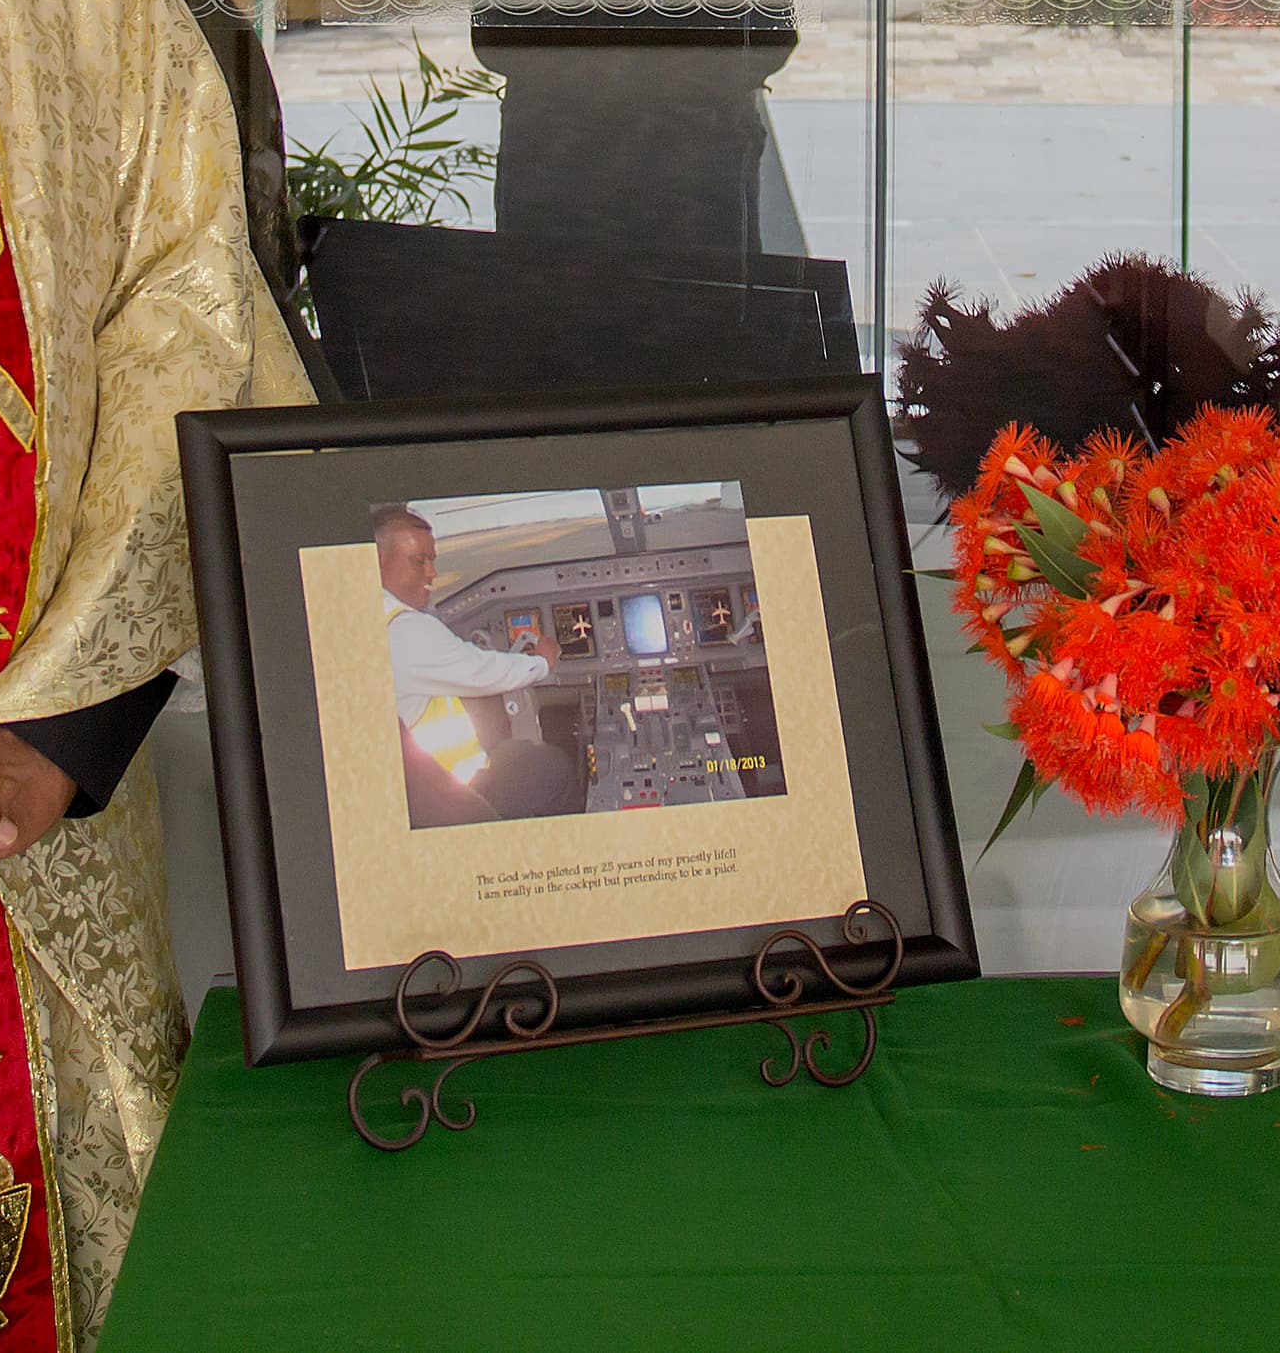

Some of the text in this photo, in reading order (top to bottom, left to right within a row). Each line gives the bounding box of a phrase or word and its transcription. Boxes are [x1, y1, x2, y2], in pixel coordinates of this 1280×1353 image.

[706, 755, 767, 773] 01/18/2013
[476, 874, 494, 886] The
[498, 870, 519, 883] God
[522, 869, 543, 880] who
[547, 864, 580, 880] piloted
[583, 865, 598, 875] my
[601, 861, 614, 872] 25
[617, 860, 642, 872] years
[645, 856, 655, 867] of
[658, 857, 673, 867] my
[676, 850, 712, 866] priestly
[484, 890, 500, 899] am
[504, 885, 531, 897] really
[535, 885, 544, 894] in
[548, 881, 563, 893] the
[565, 878, 601, 891] cockpit
[604, 876, 620, 887] but
[623, 870, 677, 887] pretending
[680, 868, 689, 878] to
[691, 865, 702, 877] be
